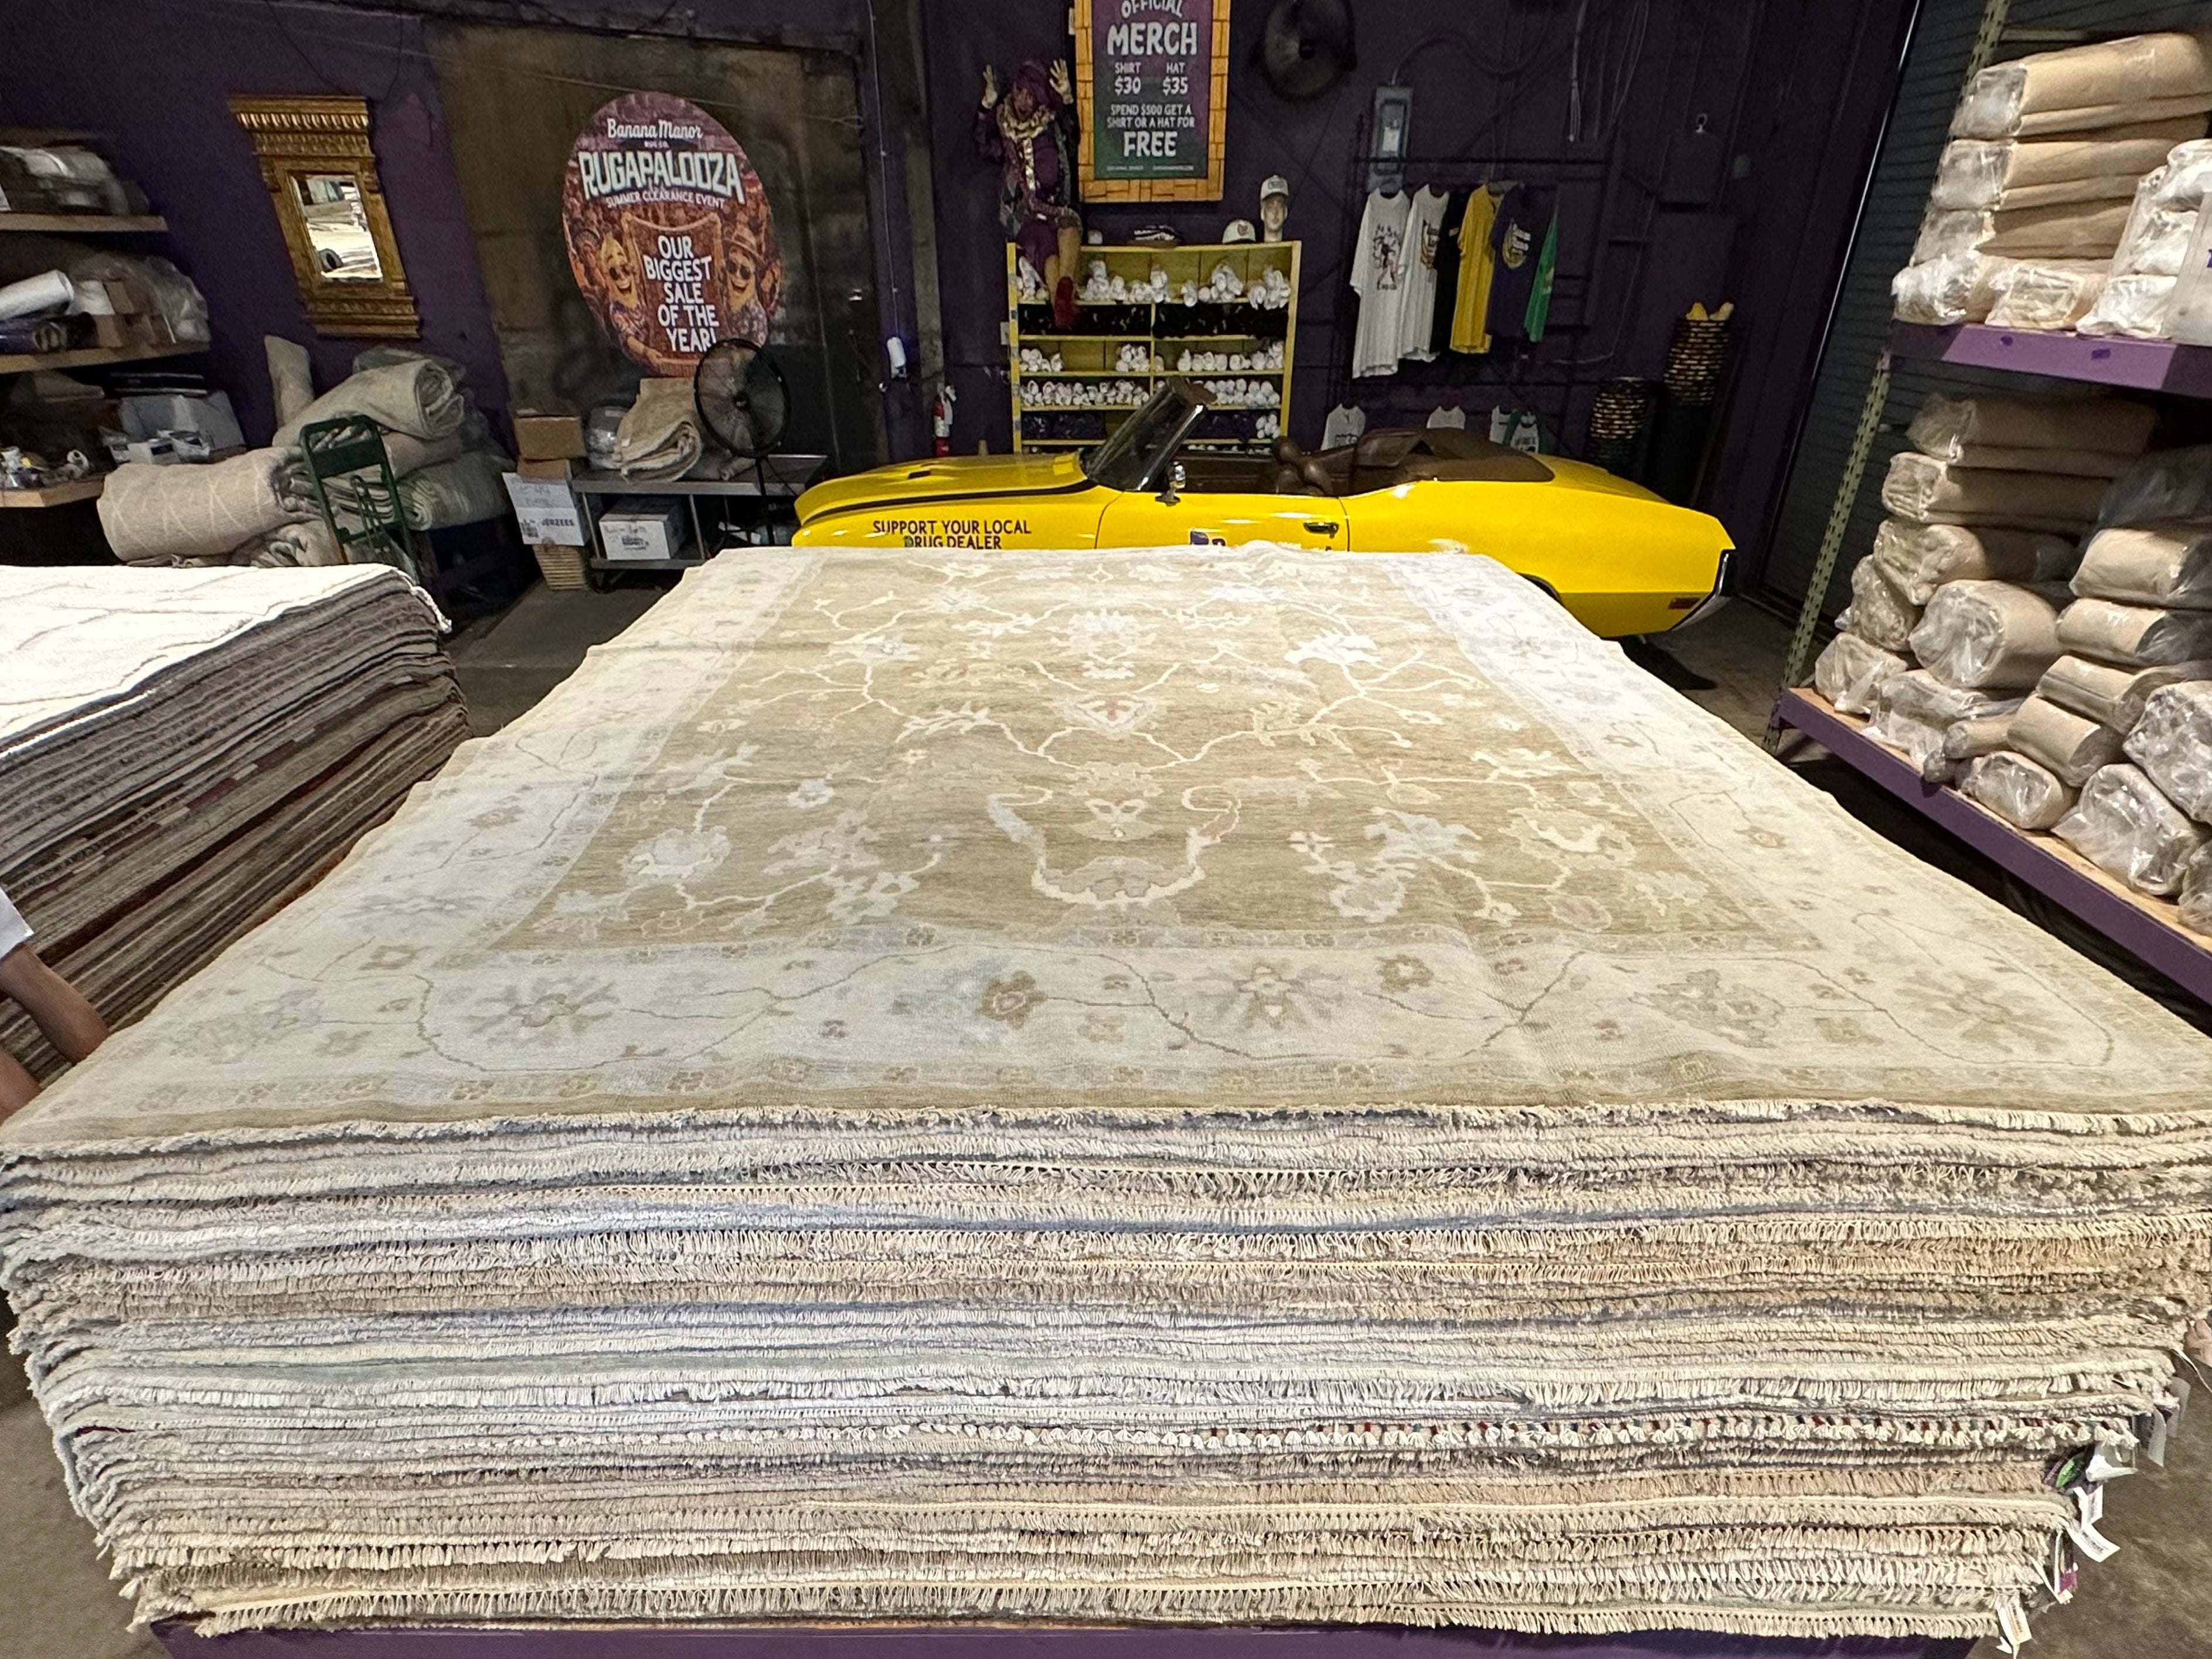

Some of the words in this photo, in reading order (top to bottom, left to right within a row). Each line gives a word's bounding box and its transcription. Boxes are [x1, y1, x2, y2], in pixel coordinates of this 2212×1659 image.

[1107, 22, 1197, 55] MERCH
[1115, 62, 1141, 74] SHIRT
[1166, 62, 1185, 74] HAT
[1115, 76, 1141, 96] $30
[1163, 76, 1188, 96] $35
[1111, 104, 1139, 115] SPEND
[1141, 104, 1163, 116] $500
[1164, 104, 1183, 115] GET
[1185, 104, 1192, 115] A
[607, 118, 658, 138] Banana
[658, 119, 703, 139] Manor
[1107, 117, 1132, 128] SHIRT
[1134, 117, 1148, 128] OR
[1149, 117, 1156, 128] A
[1157, 117, 1176, 128] HAT
[1177, 117, 1195, 128] FOR
[1123, 131, 1178, 157] FREE
[577, 150, 745, 205] RUGAPALOOZA
[605, 191, 642, 208] SUMMER
[642, 191, 693, 203] CLEARANCE
[695, 193, 725, 208] EVENT
[658, 235, 694, 259] OUR
[643, 254, 712, 281] BIGGEST
[663, 282, 703, 304] SALE
[658, 304, 679, 327] OF
[683, 305, 719, 327] THE
[666, 327, 717, 352] YEAR!
[873, 520, 937, 535] SUPPORT
[941, 520, 980, 534] YOUR
[984, 520, 1032, 534] LOCAL
[904, 536, 943, 548] DRUG
[947, 536, 1002, 550] DEALER
